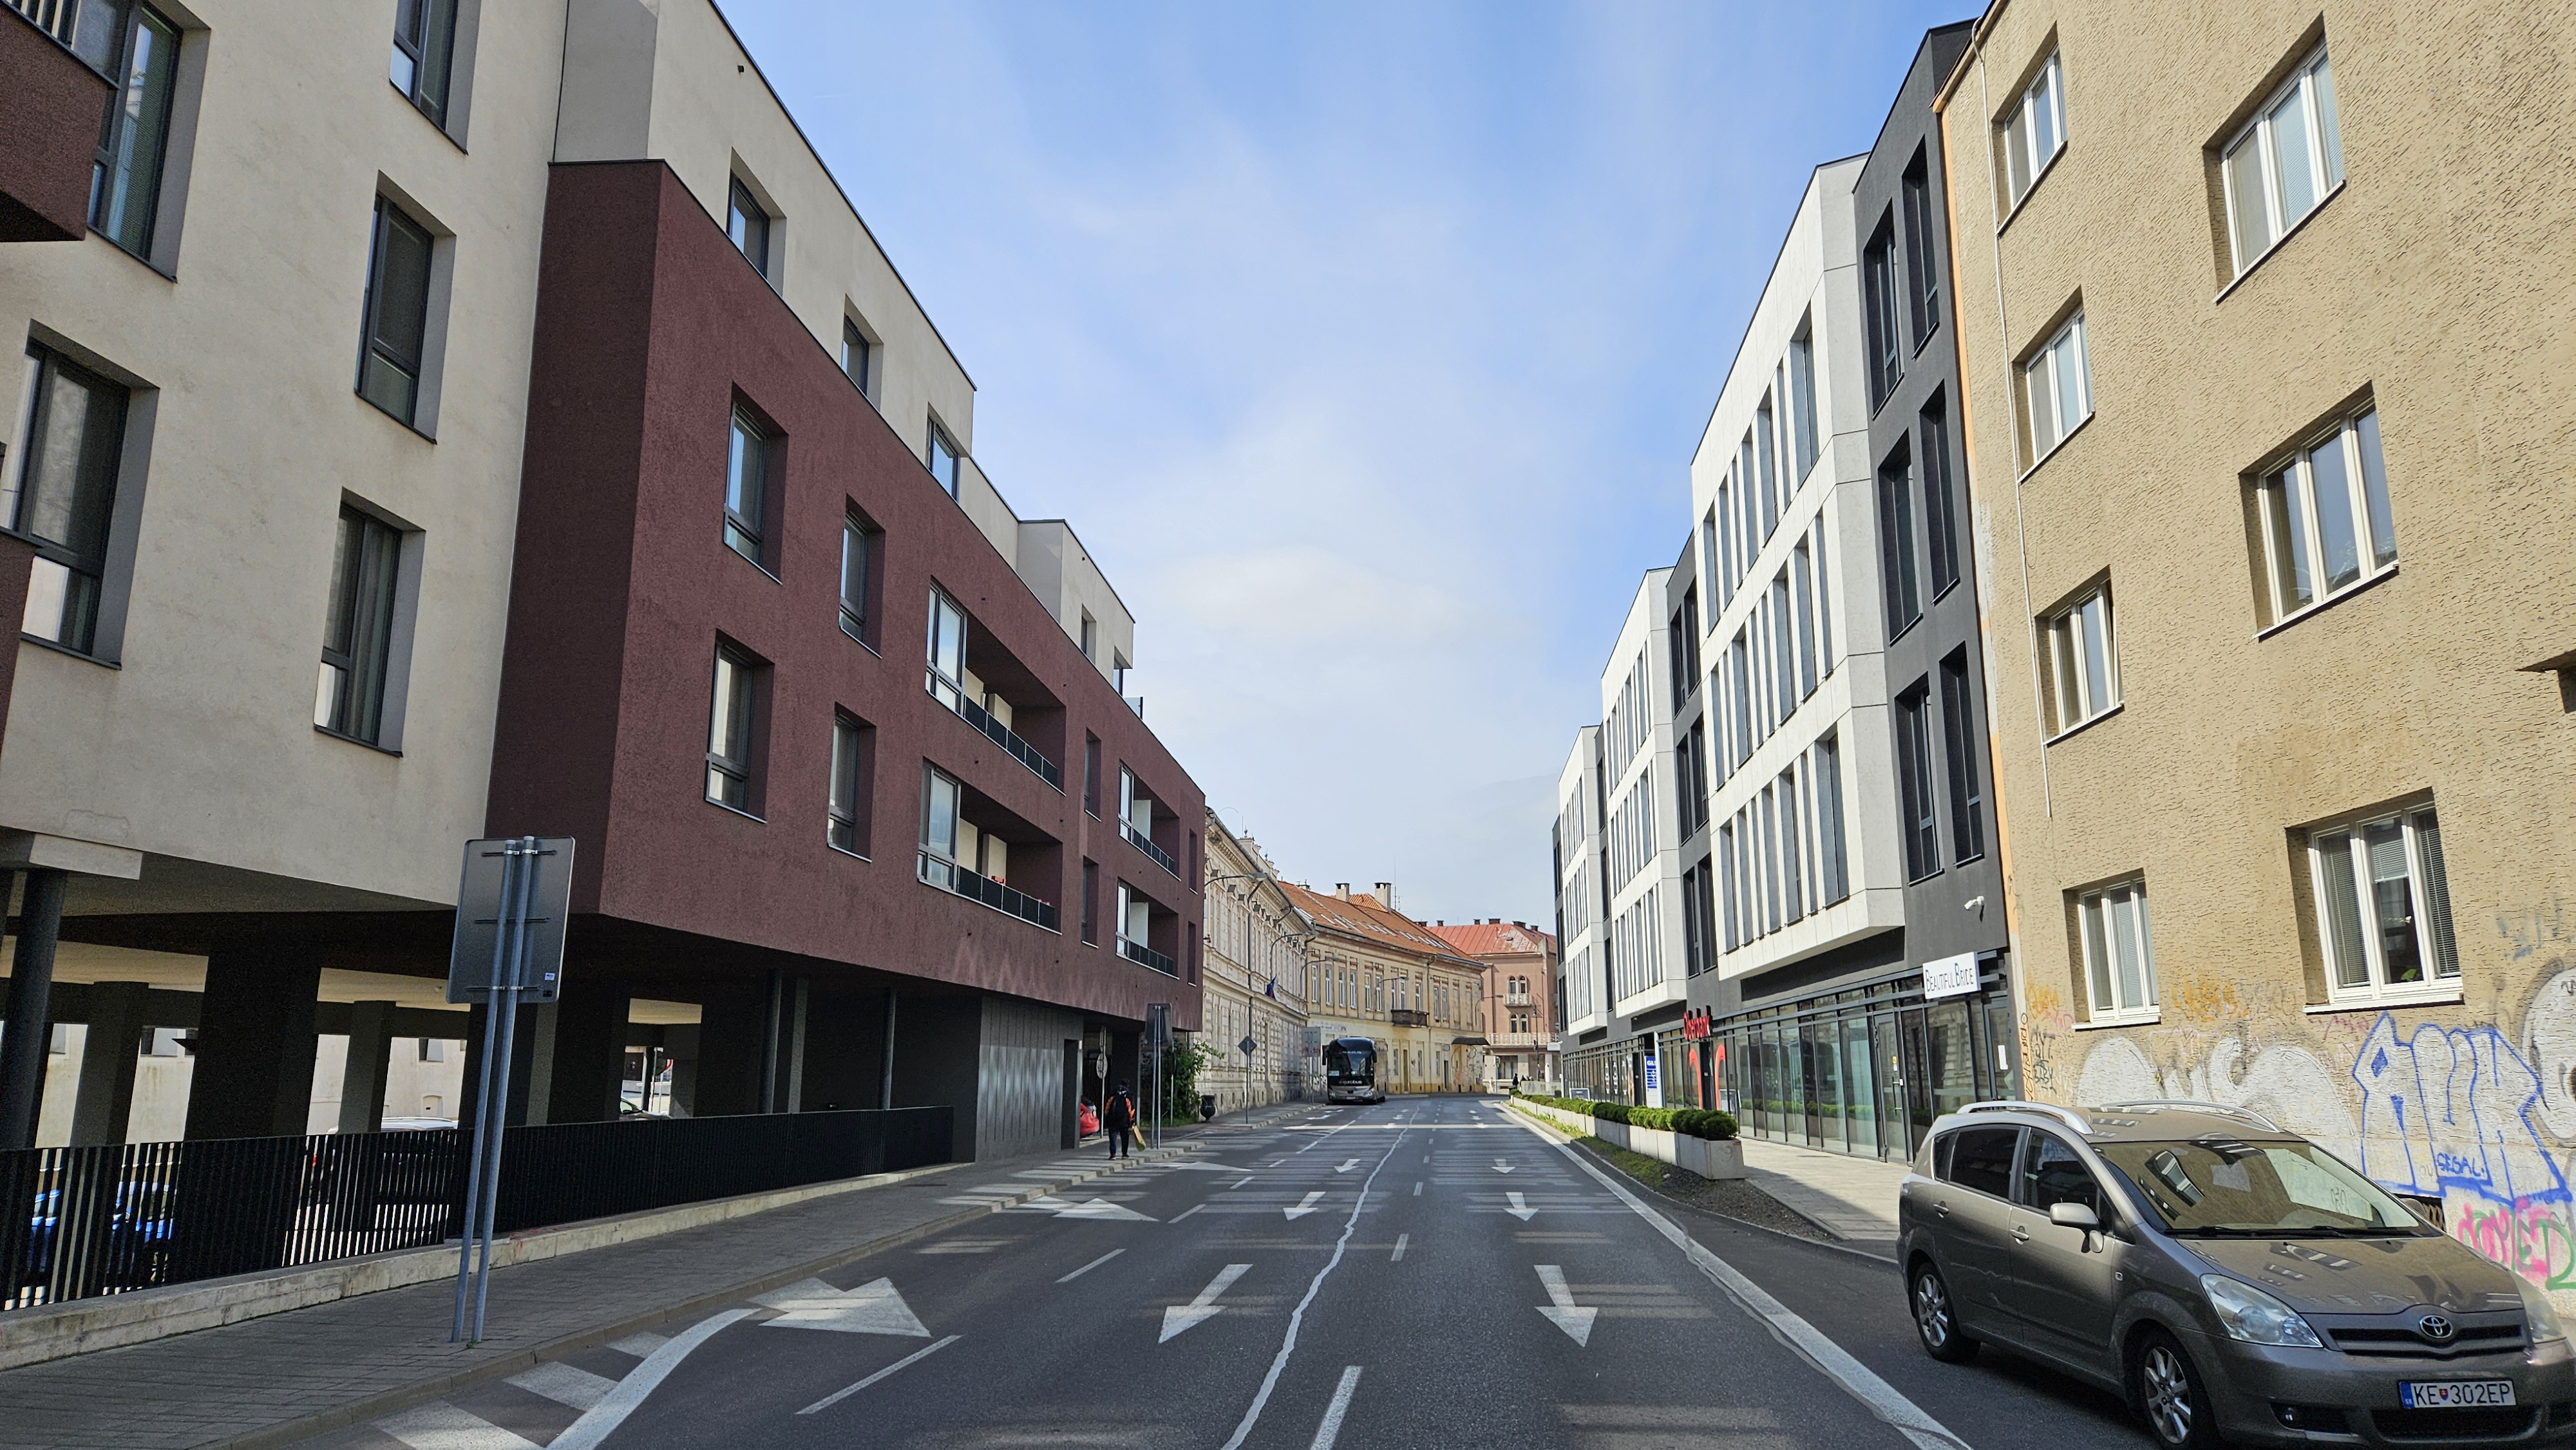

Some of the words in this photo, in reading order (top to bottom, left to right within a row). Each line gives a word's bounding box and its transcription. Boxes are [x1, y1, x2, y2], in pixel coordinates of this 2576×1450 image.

[1925, 969, 1955, 992] BEAUTIFUL
[1955, 963, 1974, 986] BRIDE
[2449, 1383, 2510, 1404] 302EP
